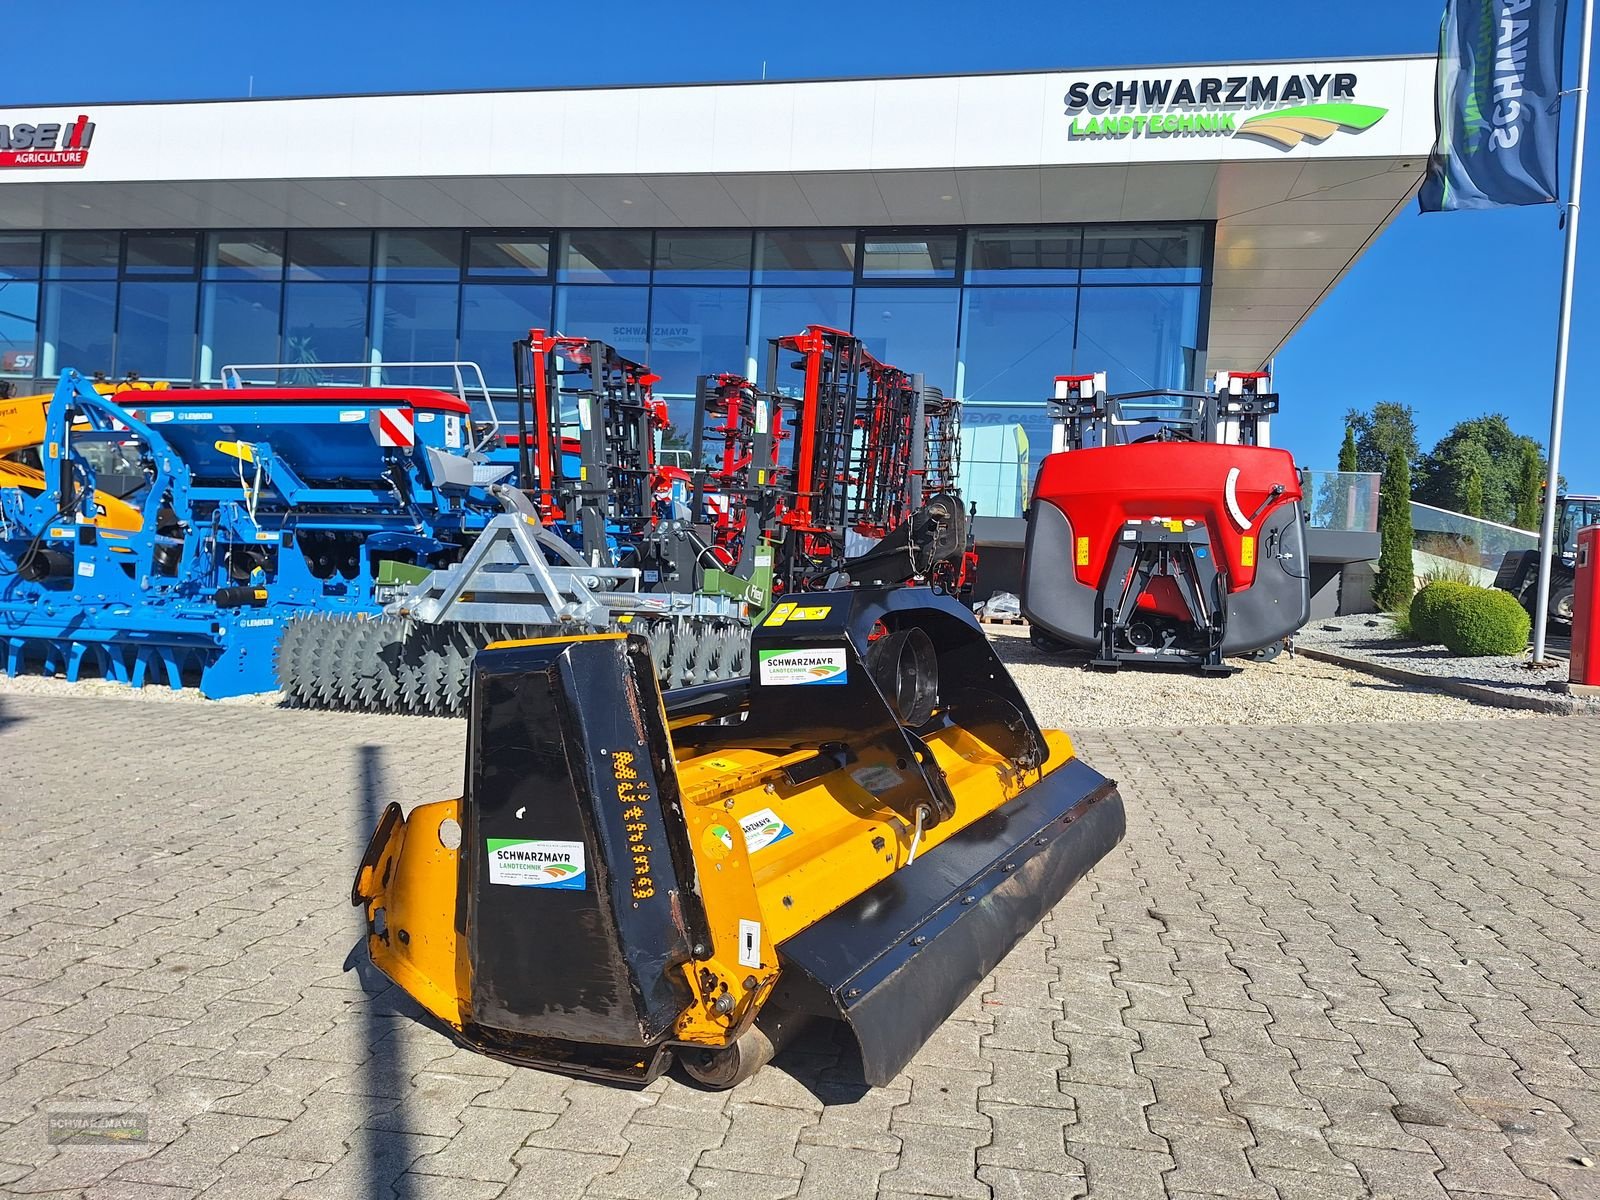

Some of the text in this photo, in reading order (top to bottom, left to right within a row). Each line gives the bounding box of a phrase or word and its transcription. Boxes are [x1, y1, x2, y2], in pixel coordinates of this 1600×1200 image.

[1067, 72, 1358, 108] SCHWARZMAYR
[1071, 112, 1237, 136] LANDTECHNIK
[15, 152, 82, 163] AGRICULTURE
[613, 326, 689, 336] SCHWAZMAYR
[961, 412, 1003, 424] TEYR
[246, 618, 274, 628] LEMKEN
[767, 657, 833, 667] SCHWARZMAYR
[611, 751, 655, 899] Müthing
[497, 850, 571, 863] SCHWARZMAYR
[499, 862, 542, 871] LANDTECHNIK
